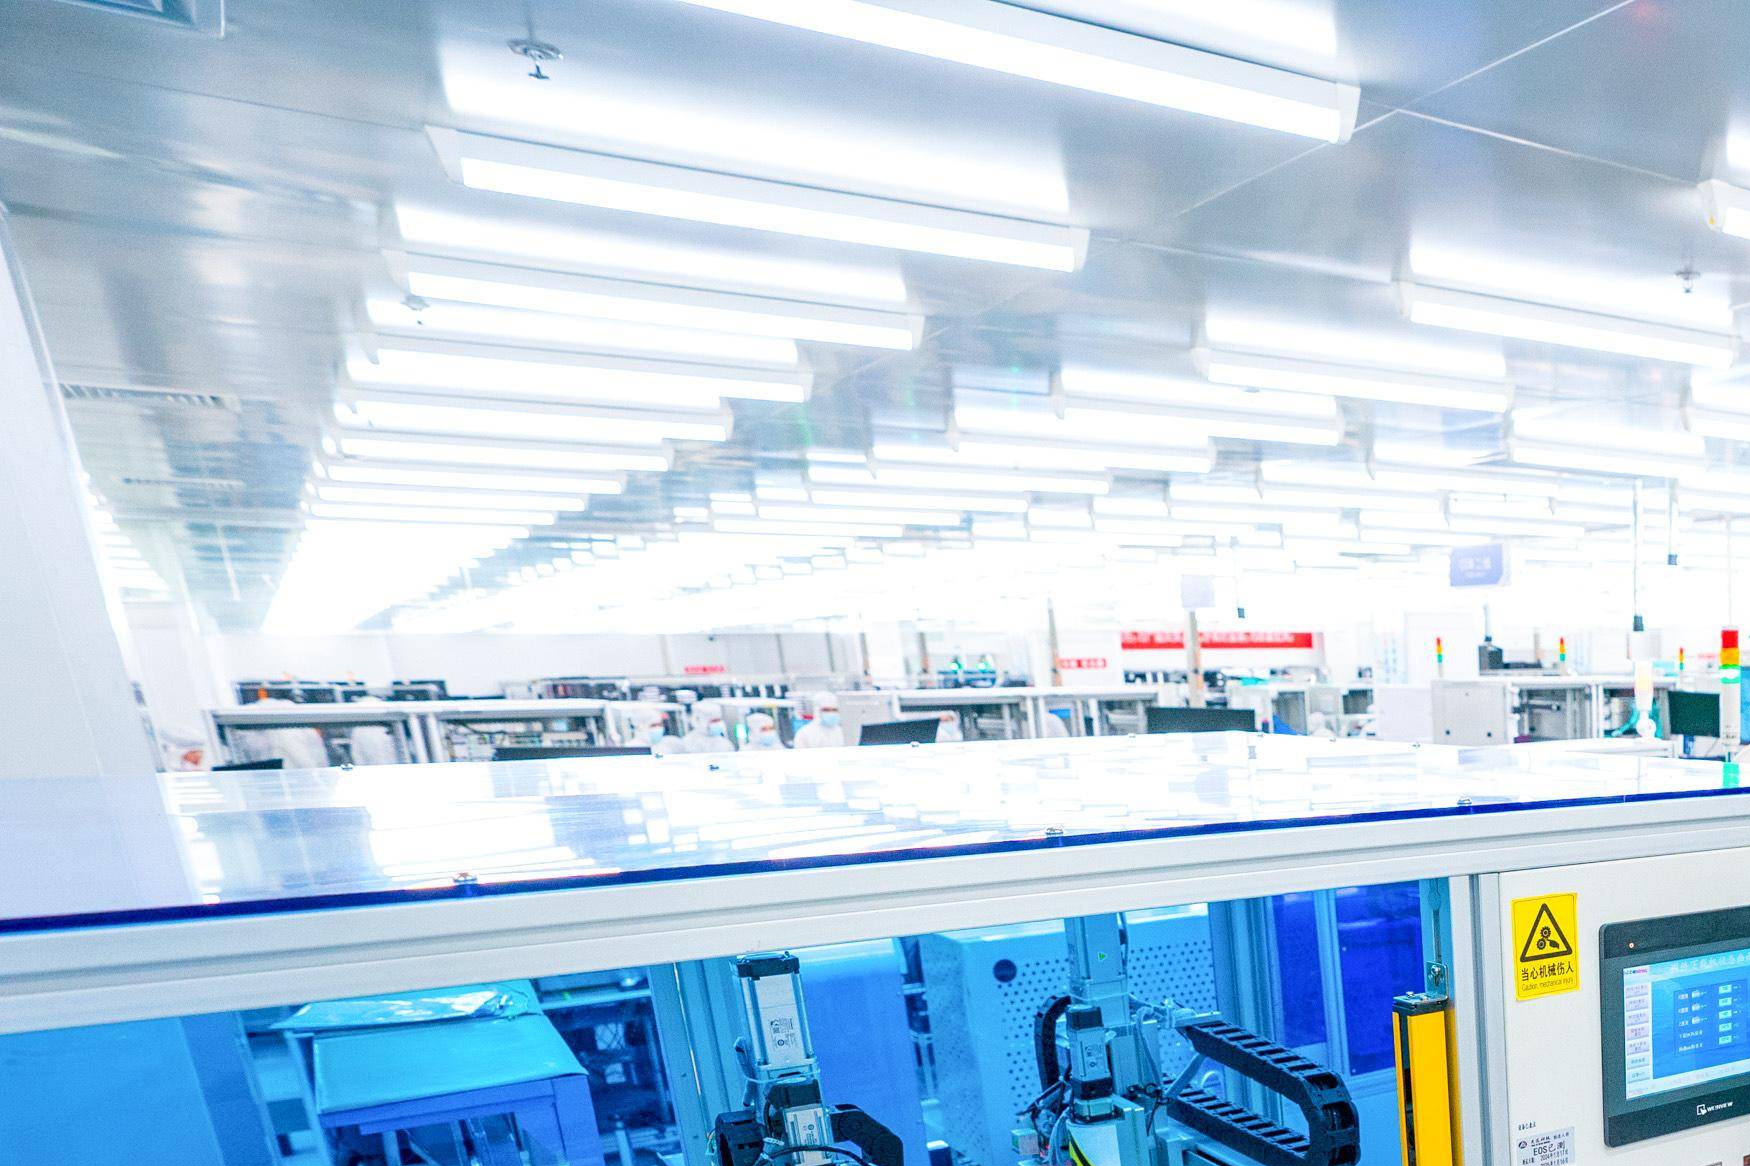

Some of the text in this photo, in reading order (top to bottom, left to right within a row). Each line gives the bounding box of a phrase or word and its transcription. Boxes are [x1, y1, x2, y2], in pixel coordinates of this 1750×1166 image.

[1521, 961, 1575, 981] 当心机械伤人
